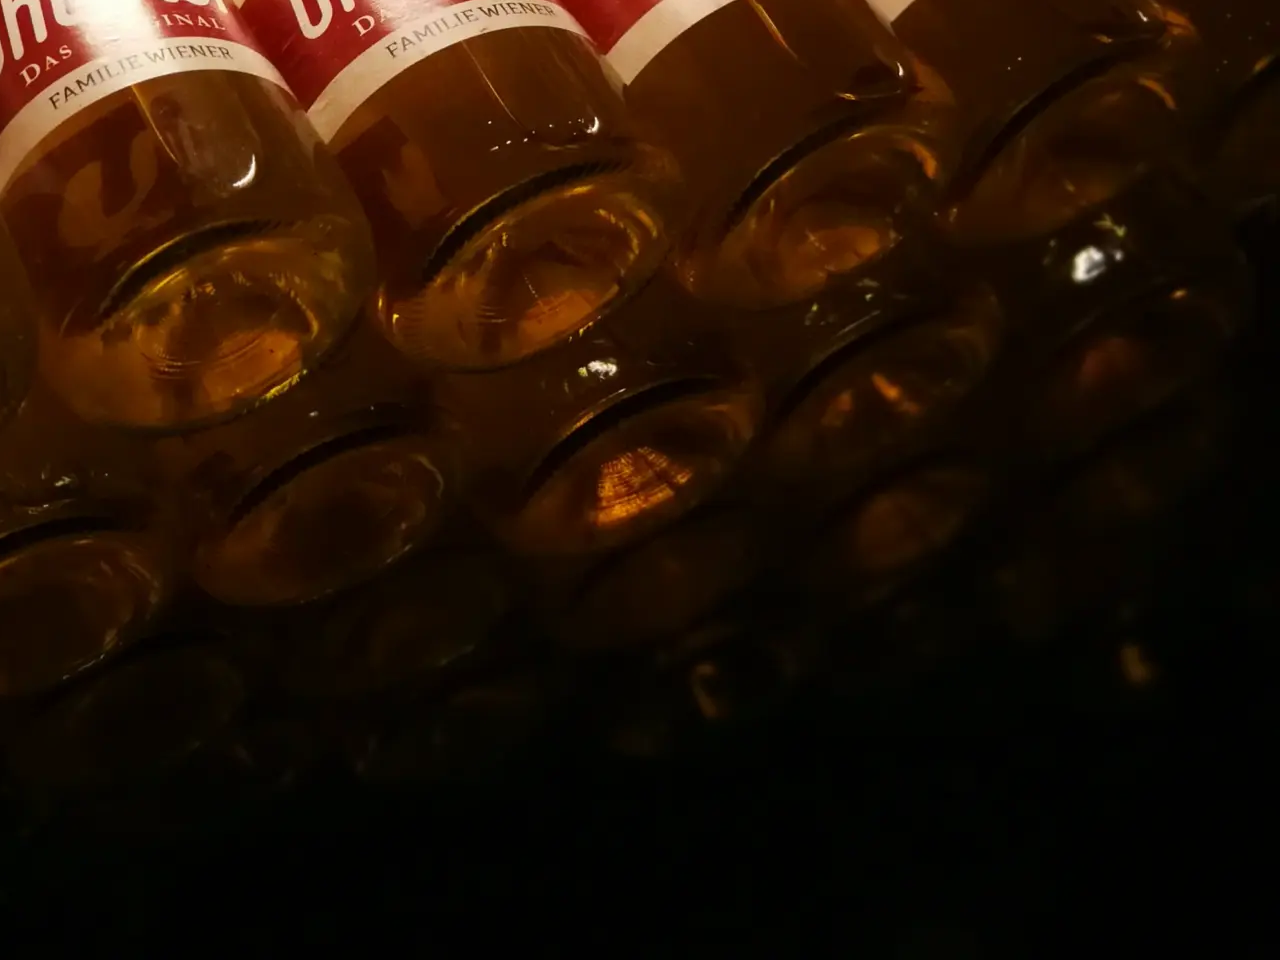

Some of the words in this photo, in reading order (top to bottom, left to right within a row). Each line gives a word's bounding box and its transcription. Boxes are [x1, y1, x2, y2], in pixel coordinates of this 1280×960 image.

[384, 7, 479, 59] FAMILIE
[476, 0, 556, 22] WIENER
[19, 44, 73, 87] DAS
[48, 53, 144, 111] FAMILIE
[144, 44, 235, 66] WIENER
